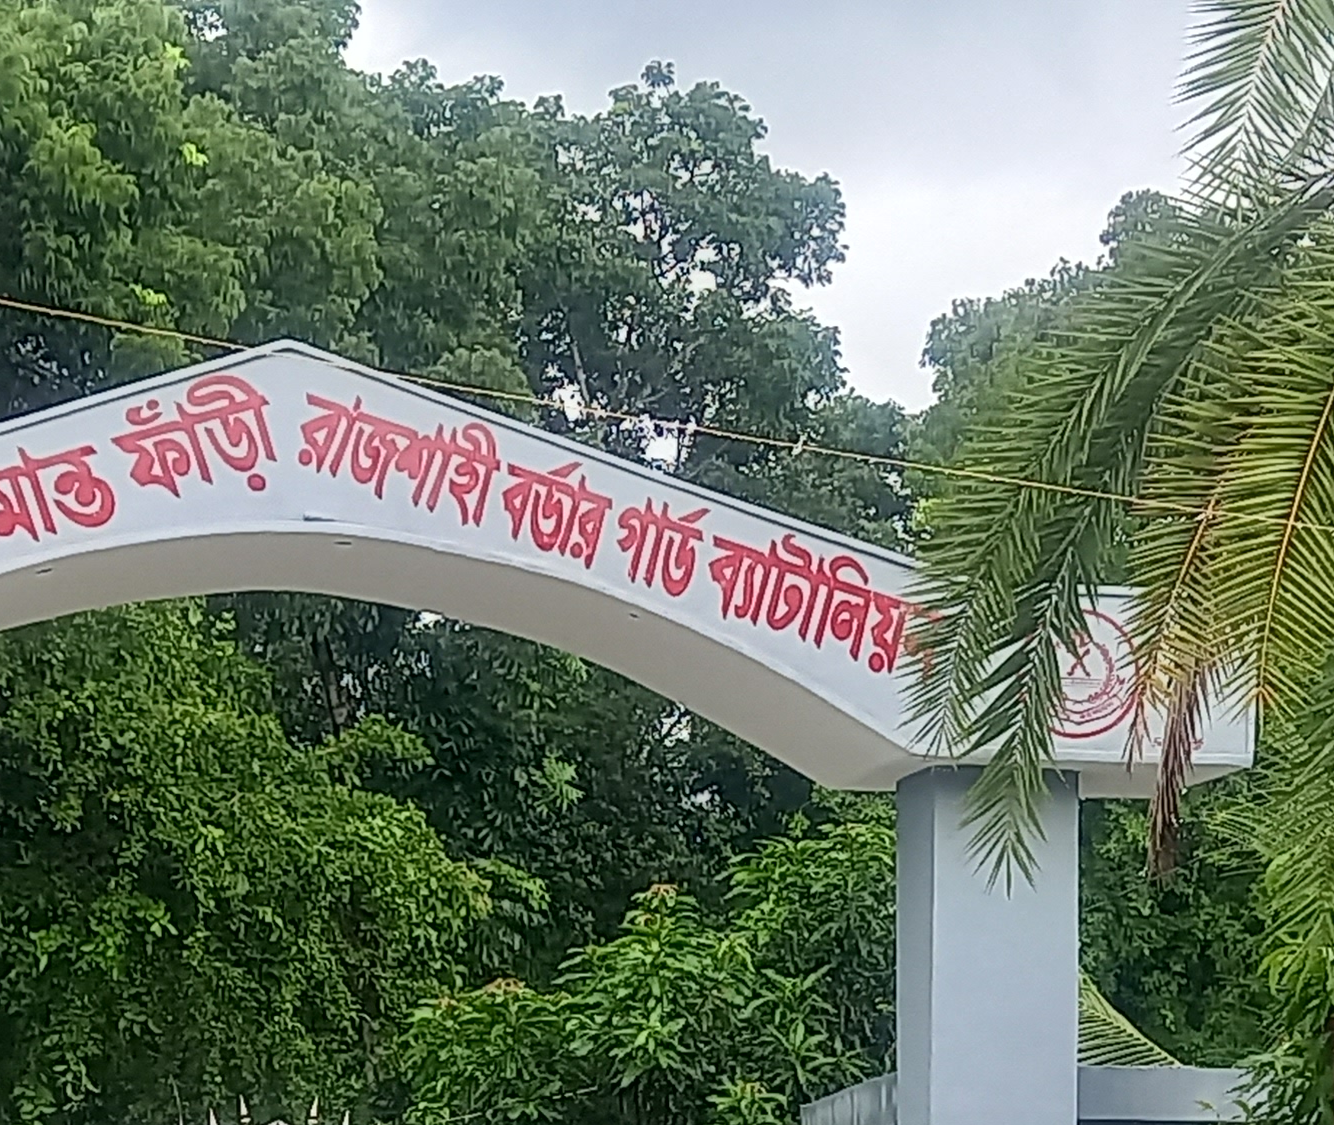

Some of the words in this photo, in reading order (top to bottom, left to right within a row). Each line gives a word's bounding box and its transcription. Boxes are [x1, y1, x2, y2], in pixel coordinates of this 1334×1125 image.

[298, 392, 501, 528] রাজশাহী
[502, 461, 613, 570] বর্ডার
[617, 497, 711, 597] গার্ড
